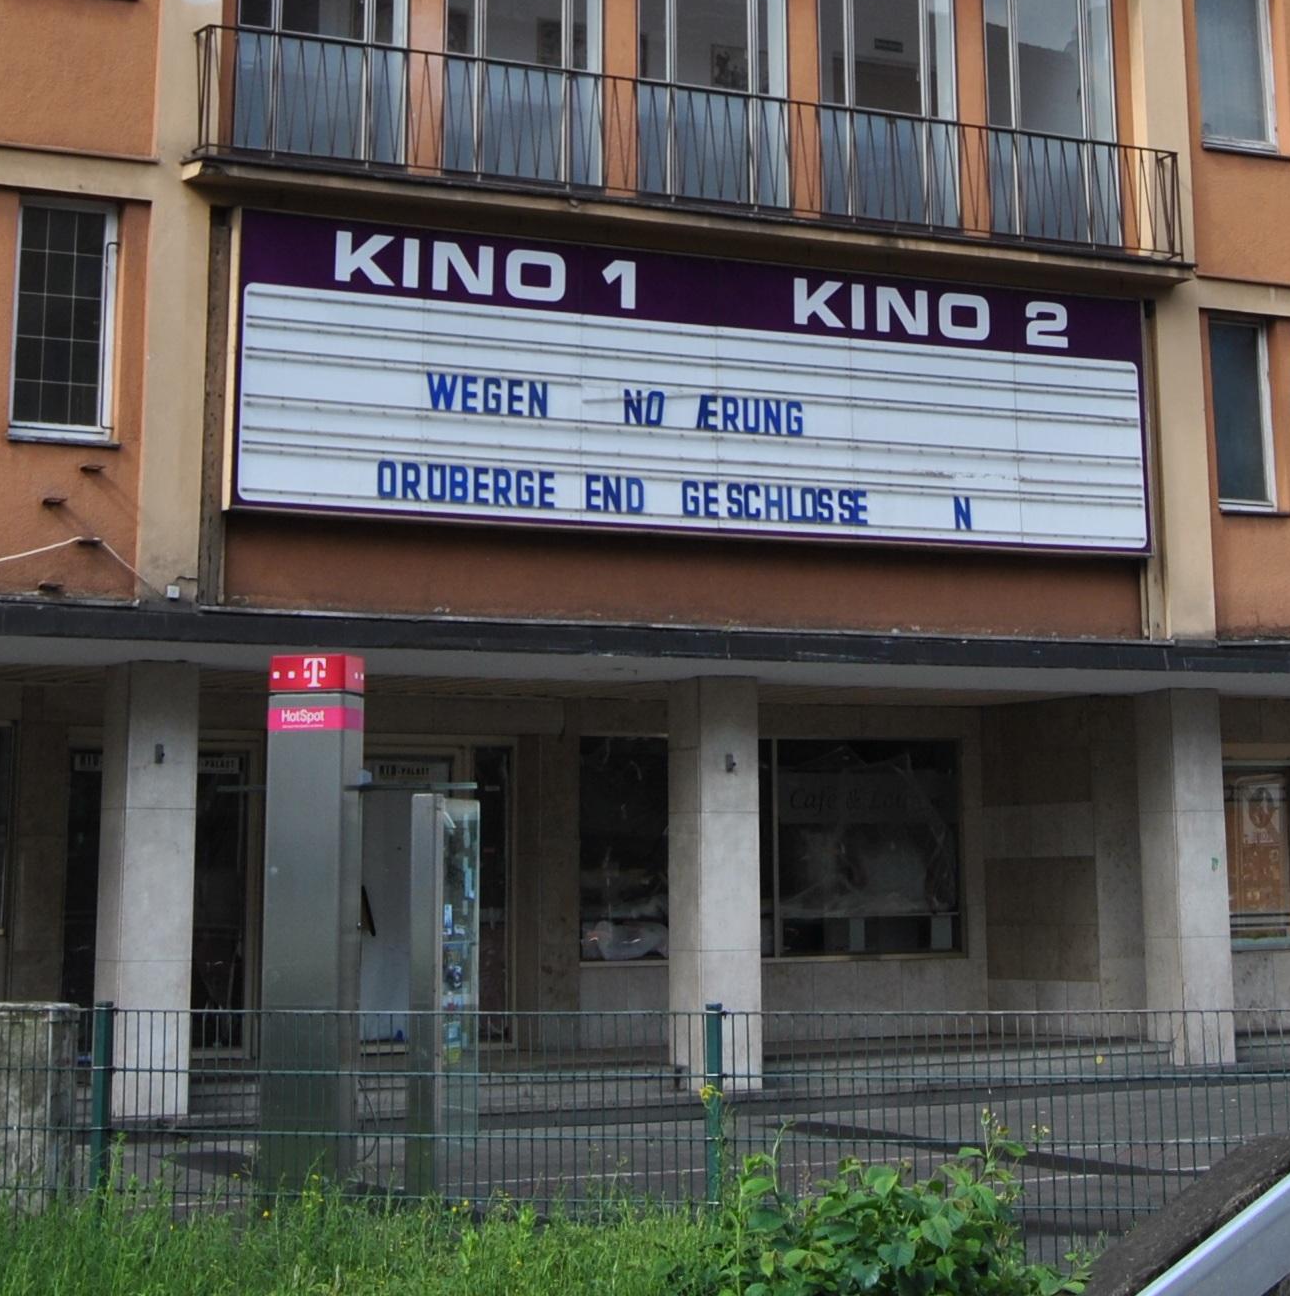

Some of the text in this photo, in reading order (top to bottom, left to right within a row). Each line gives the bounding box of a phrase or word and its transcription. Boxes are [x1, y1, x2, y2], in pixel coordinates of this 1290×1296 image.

[334, 230, 637, 310] KINO 1
[793, 276, 1069, 349] KINO 2
[425, 370, 549, 418] WEGEN
[623, 388, 666, 427] NO
[585, 473, 645, 514] END
[953, 495, 973, 531] N
[281, 709, 325, 724] HotSpot
